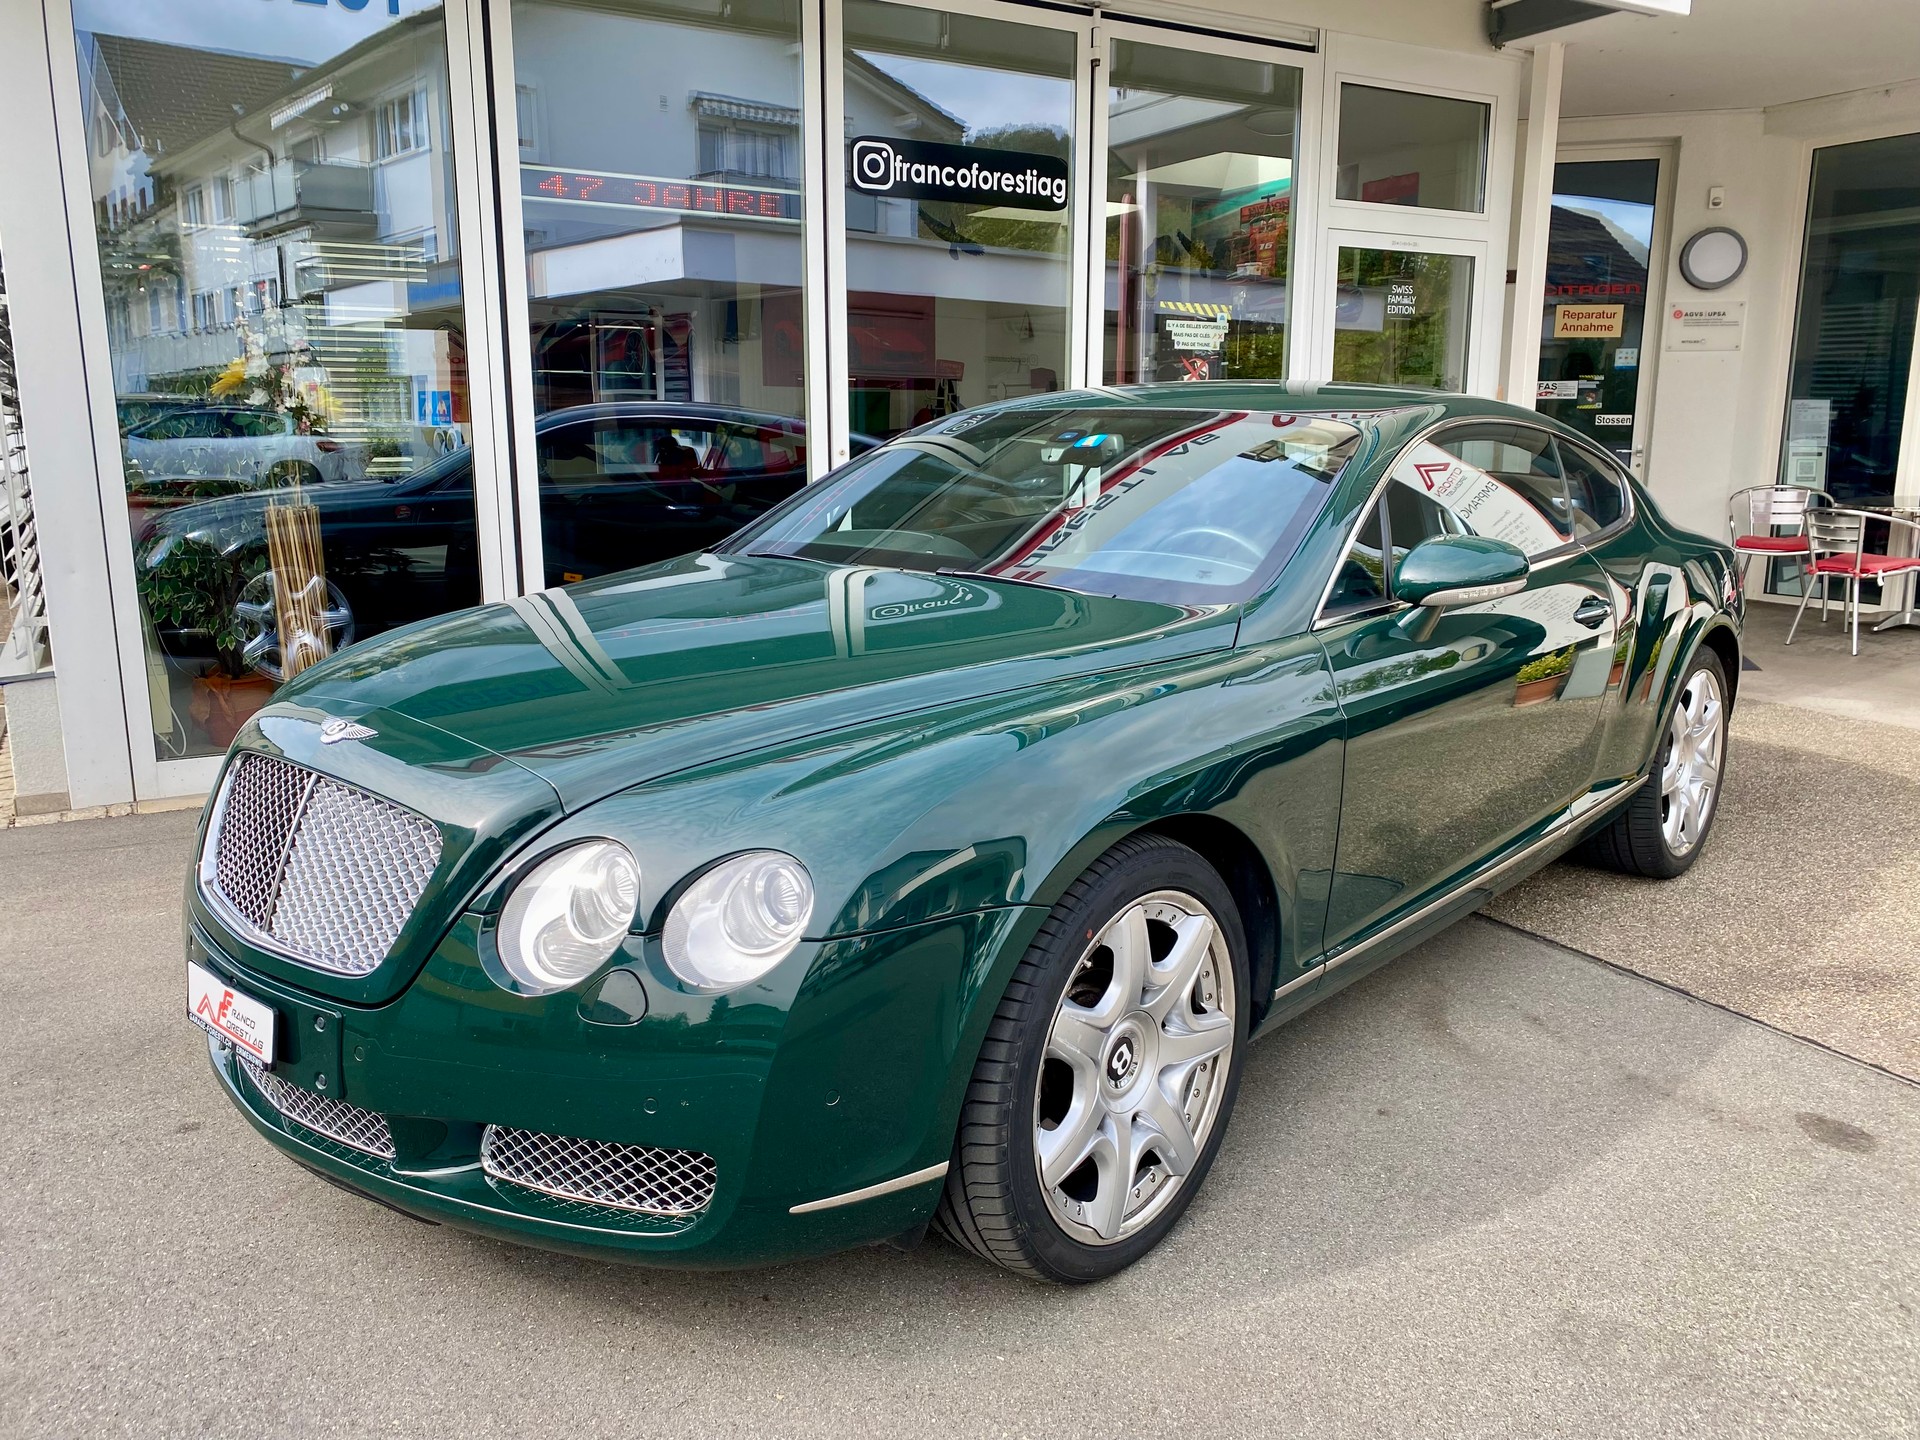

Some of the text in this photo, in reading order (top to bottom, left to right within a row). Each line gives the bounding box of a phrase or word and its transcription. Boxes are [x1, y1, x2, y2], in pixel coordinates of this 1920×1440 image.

[893, 154, 1067, 203] francoforestiag
[538, 174, 781, 216] 47 JAHRE
[1391, 284, 1414, 294] SWISS
[1387, 305, 1416, 315] EDITION
[1562, 309, 1618, 321] Reparatur
[1560, 322, 1614, 332] Annahme
[1596, 415, 1632, 424] Stossen
